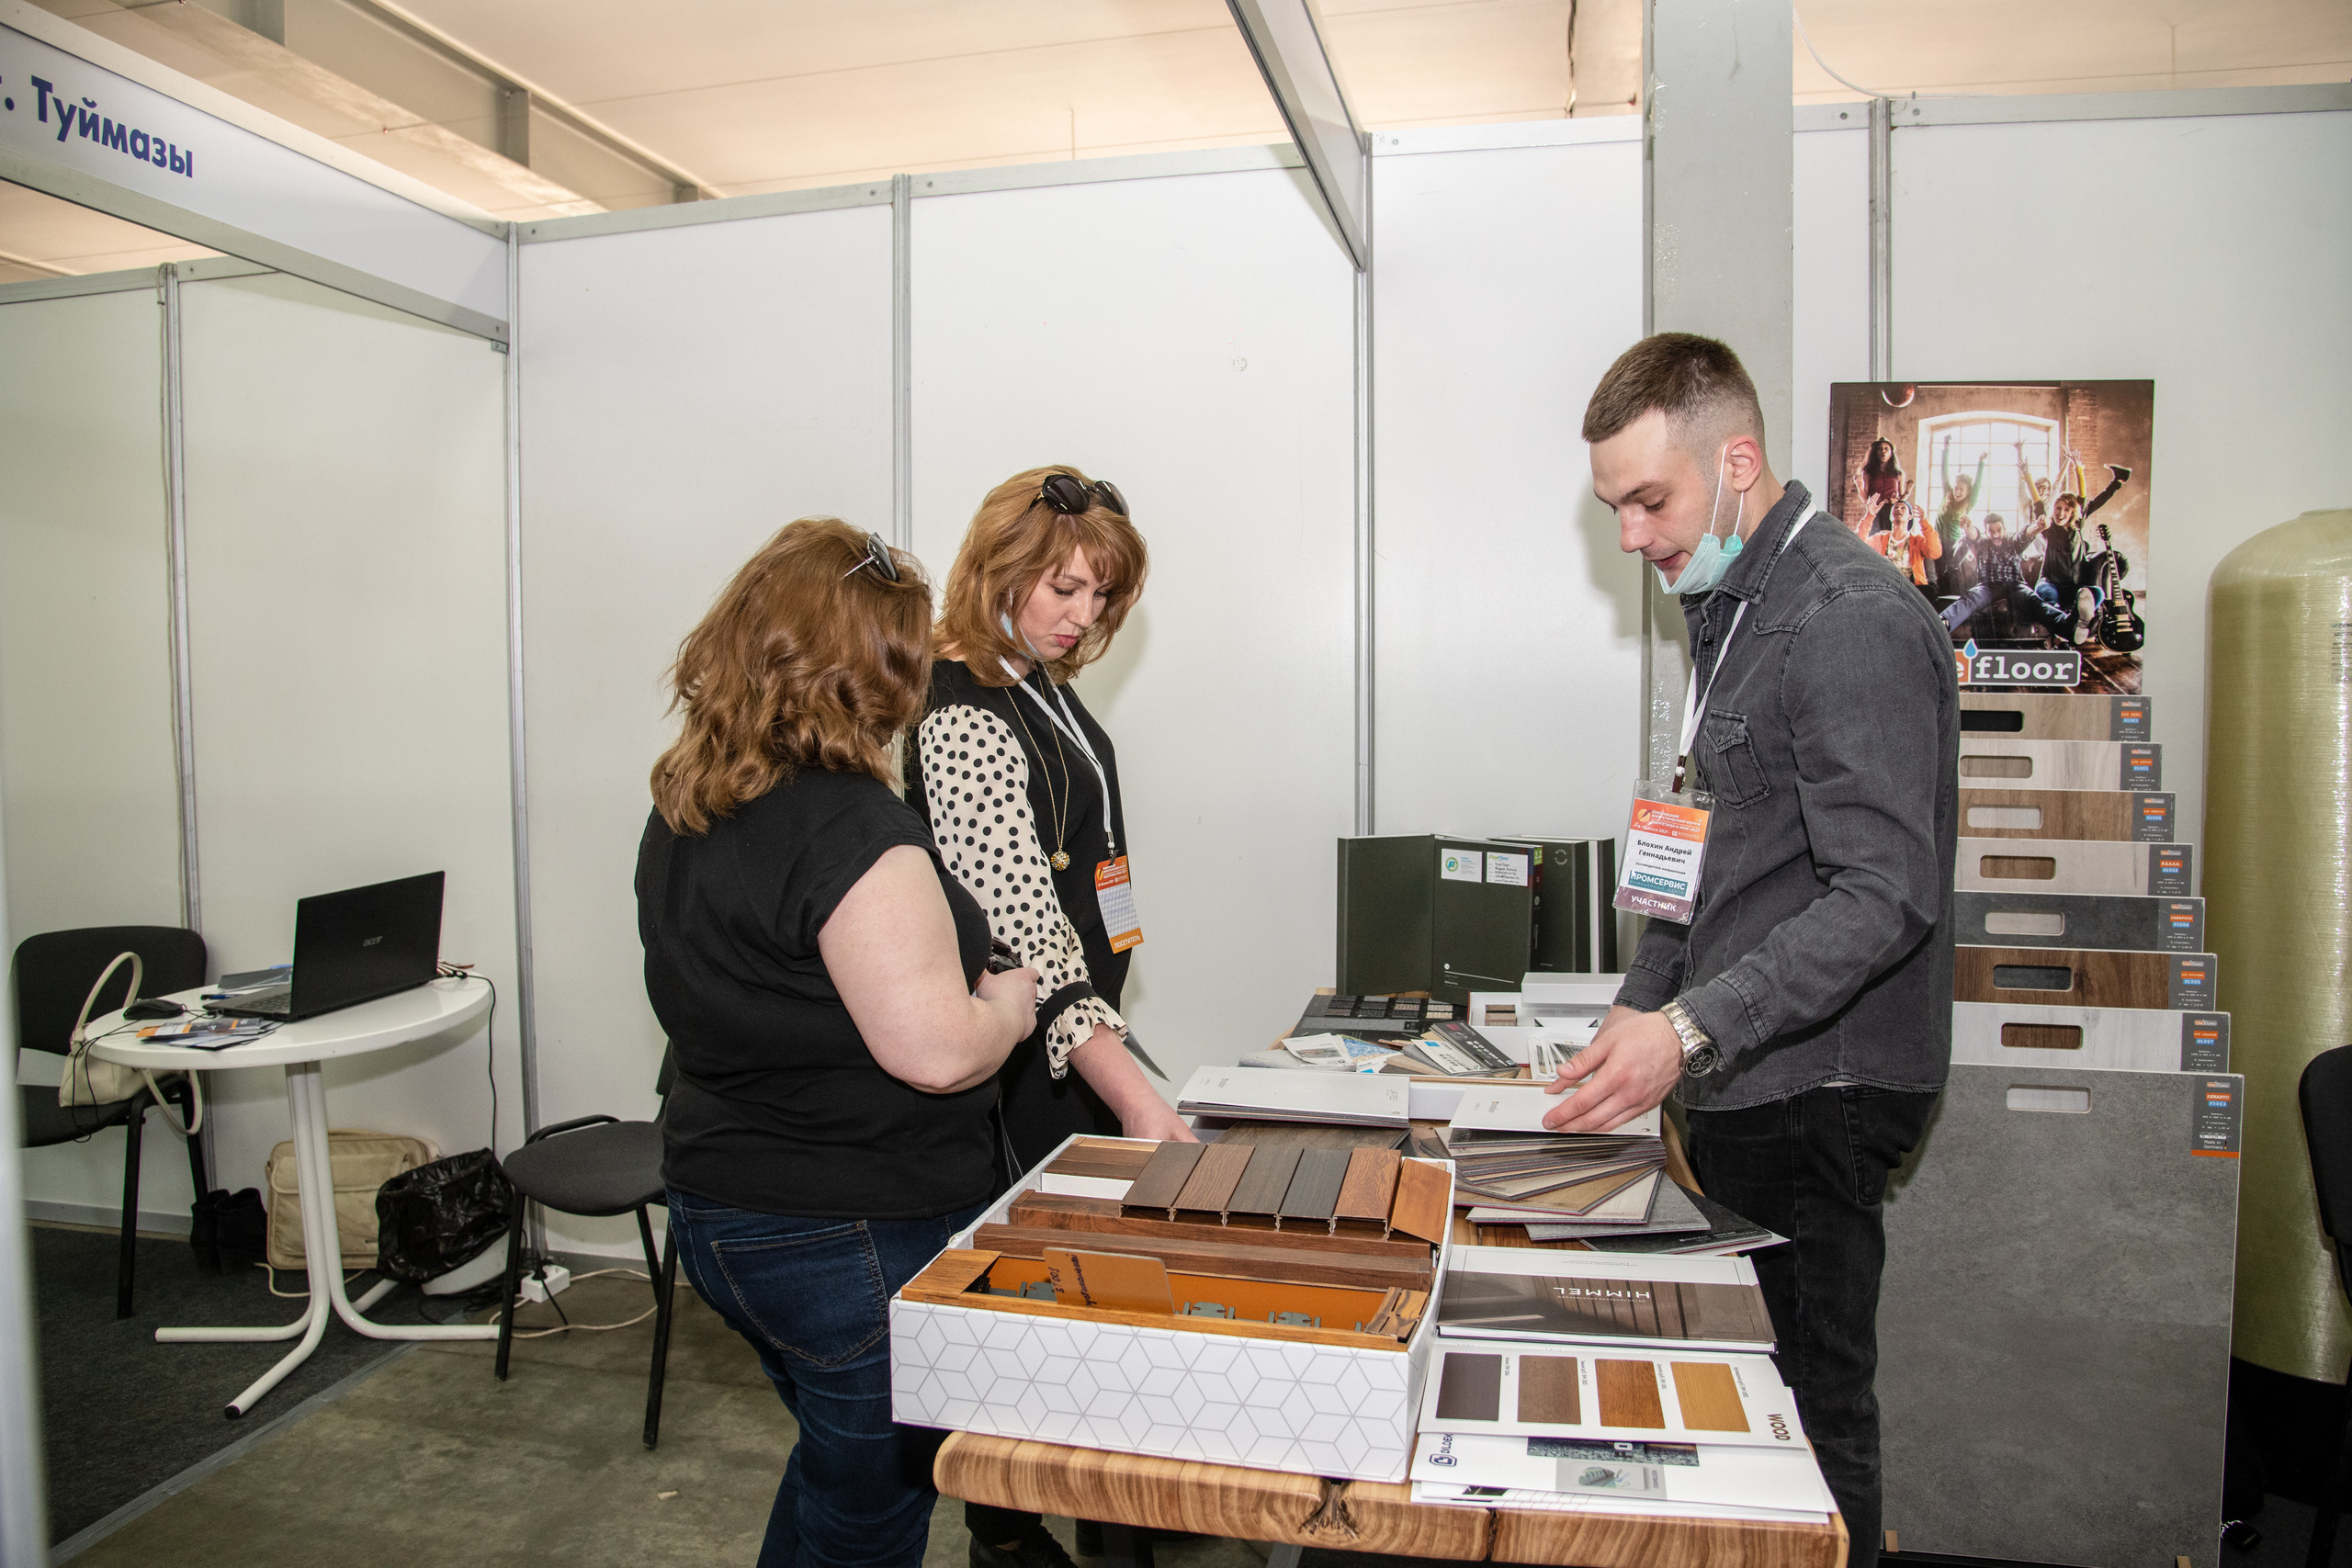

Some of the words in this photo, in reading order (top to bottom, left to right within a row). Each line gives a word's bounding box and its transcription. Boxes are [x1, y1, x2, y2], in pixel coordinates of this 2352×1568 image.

[31, 74, 193, 178] Туймазы
[1975, 656, 2074, 680] floor
[1637, 840, 1663, 850] Блохин
[1665, 845, 1691, 855] Андрей
[1639, 850, 1685, 863] Геннадьевич
[1630, 873, 1685, 890] ПРОМСЕРВИС
[1632, 895, 1677, 911] УЧАСТНИК
[1114, 935, 1141, 948] ПОСЕТИТЕЛЬ
[1553, 1287, 1650, 1299] HIMMEL
[1767, 1414, 1791, 1440] WOOD
